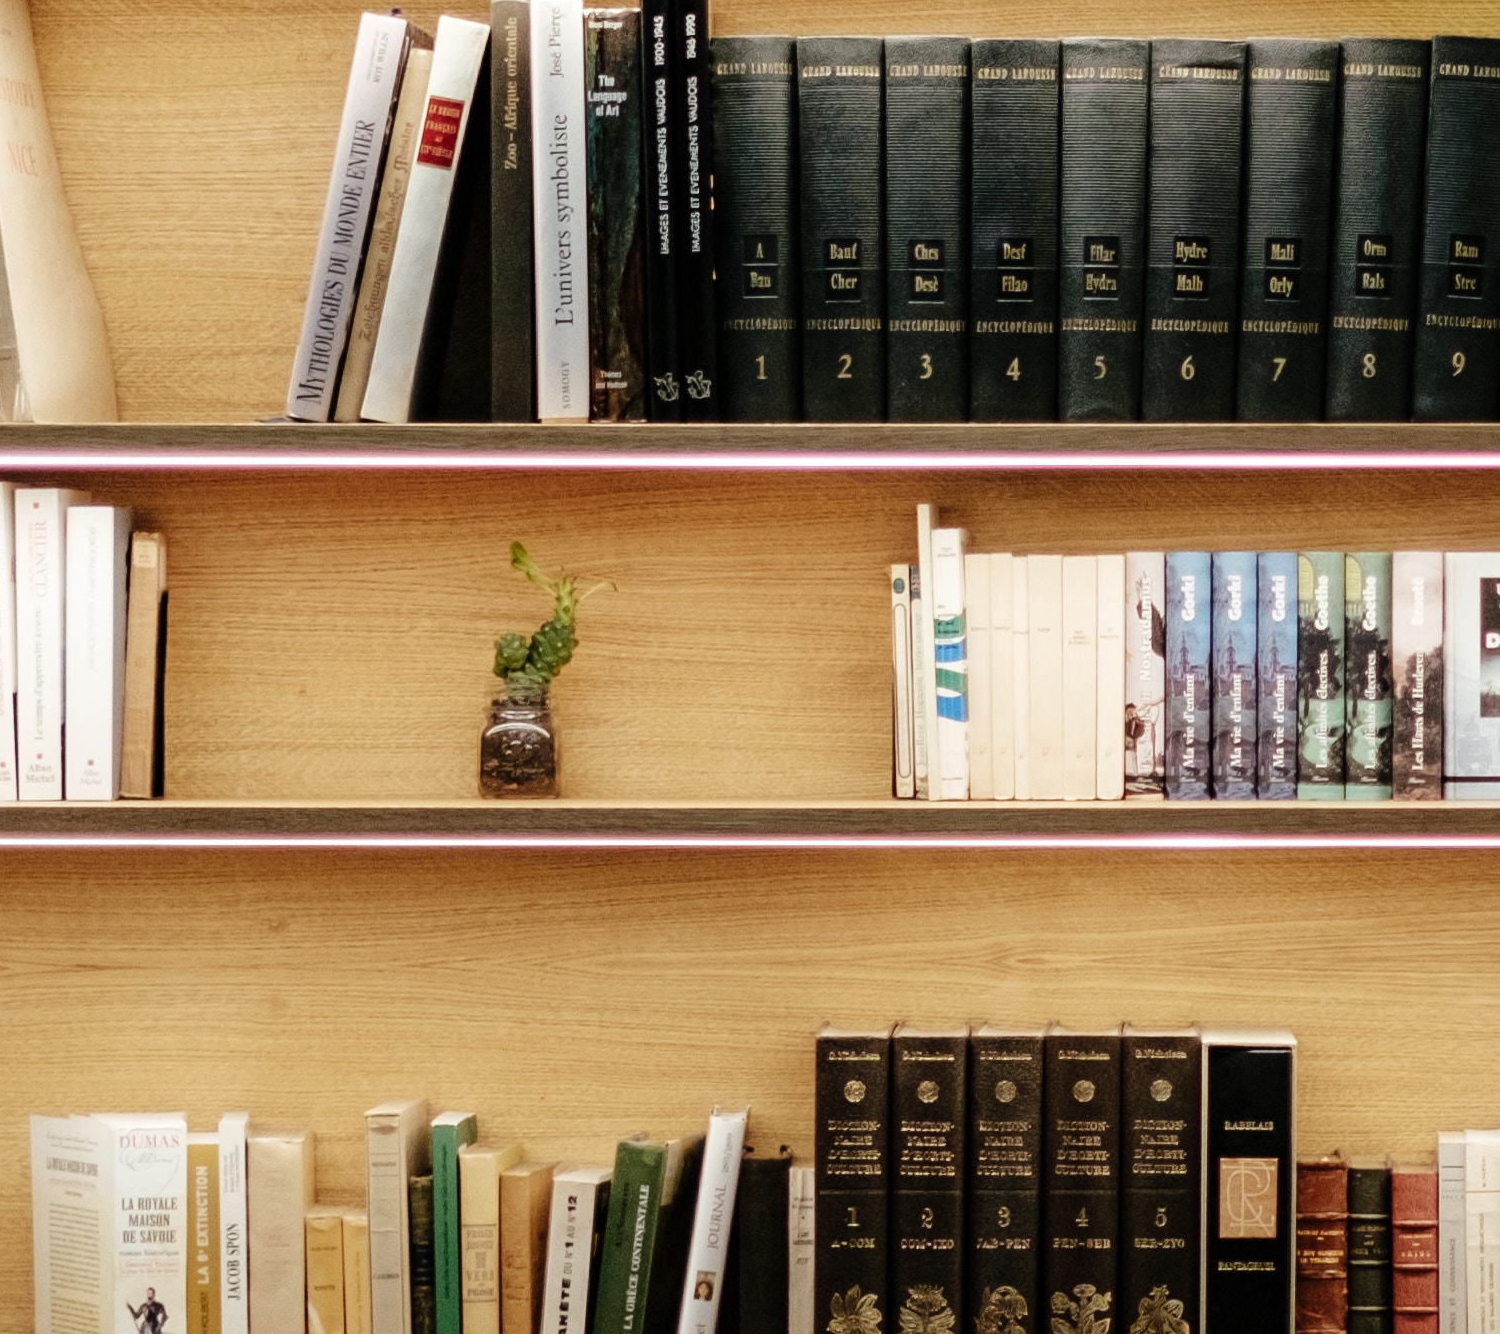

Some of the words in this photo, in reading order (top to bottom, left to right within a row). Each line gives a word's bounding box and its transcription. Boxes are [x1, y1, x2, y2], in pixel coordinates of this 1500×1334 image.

[549, 8, 561, 42] Pierre
[550, 45, 564, 78] José
[1439, 64, 1469, 77] GRAND
[346, 120, 375, 182] ENTIER
[550, 113, 573, 222] symboliste
[333, 185, 363, 247] MONDE
[328, 252, 349, 273] DU
[553, 230, 575, 327] L'univers
[756, 355, 767, 379] 1
[837, 354, 852, 378] 2
[919, 354, 933, 379] 3
[1007, 356, 1020, 380] 4
[1094, 355, 1106, 379] 5
[1181, 355, 1195, 380] 6
[1273, 358, 1286, 381] 7
[1362, 354, 1376, 378] 8
[1452, 352, 1465, 376] 9
[1181, 575, 1195, 621] Gorki
[1315, 575, 1329, 630] Goethe
[1183, 673, 1195, 723] d'enfant
[1185, 726, 1195, 743] vie
[1182, 746, 1194, 768] Ma
[120, 1135, 180, 1148] DUMAS
[122, 1198, 135, 1210] LA
[138, 1197, 177, 1210] ROYALE
[129, 1214, 170, 1226] MAISON
[707, 1184, 727, 1249] JOURNAL
[123, 1231, 136, 1243] DE
[139, 1230, 176, 1244] SAVOIE
[624, 1315, 634, 1330] LA
[632, 1185, 650, 1272] CONTINENTALE
